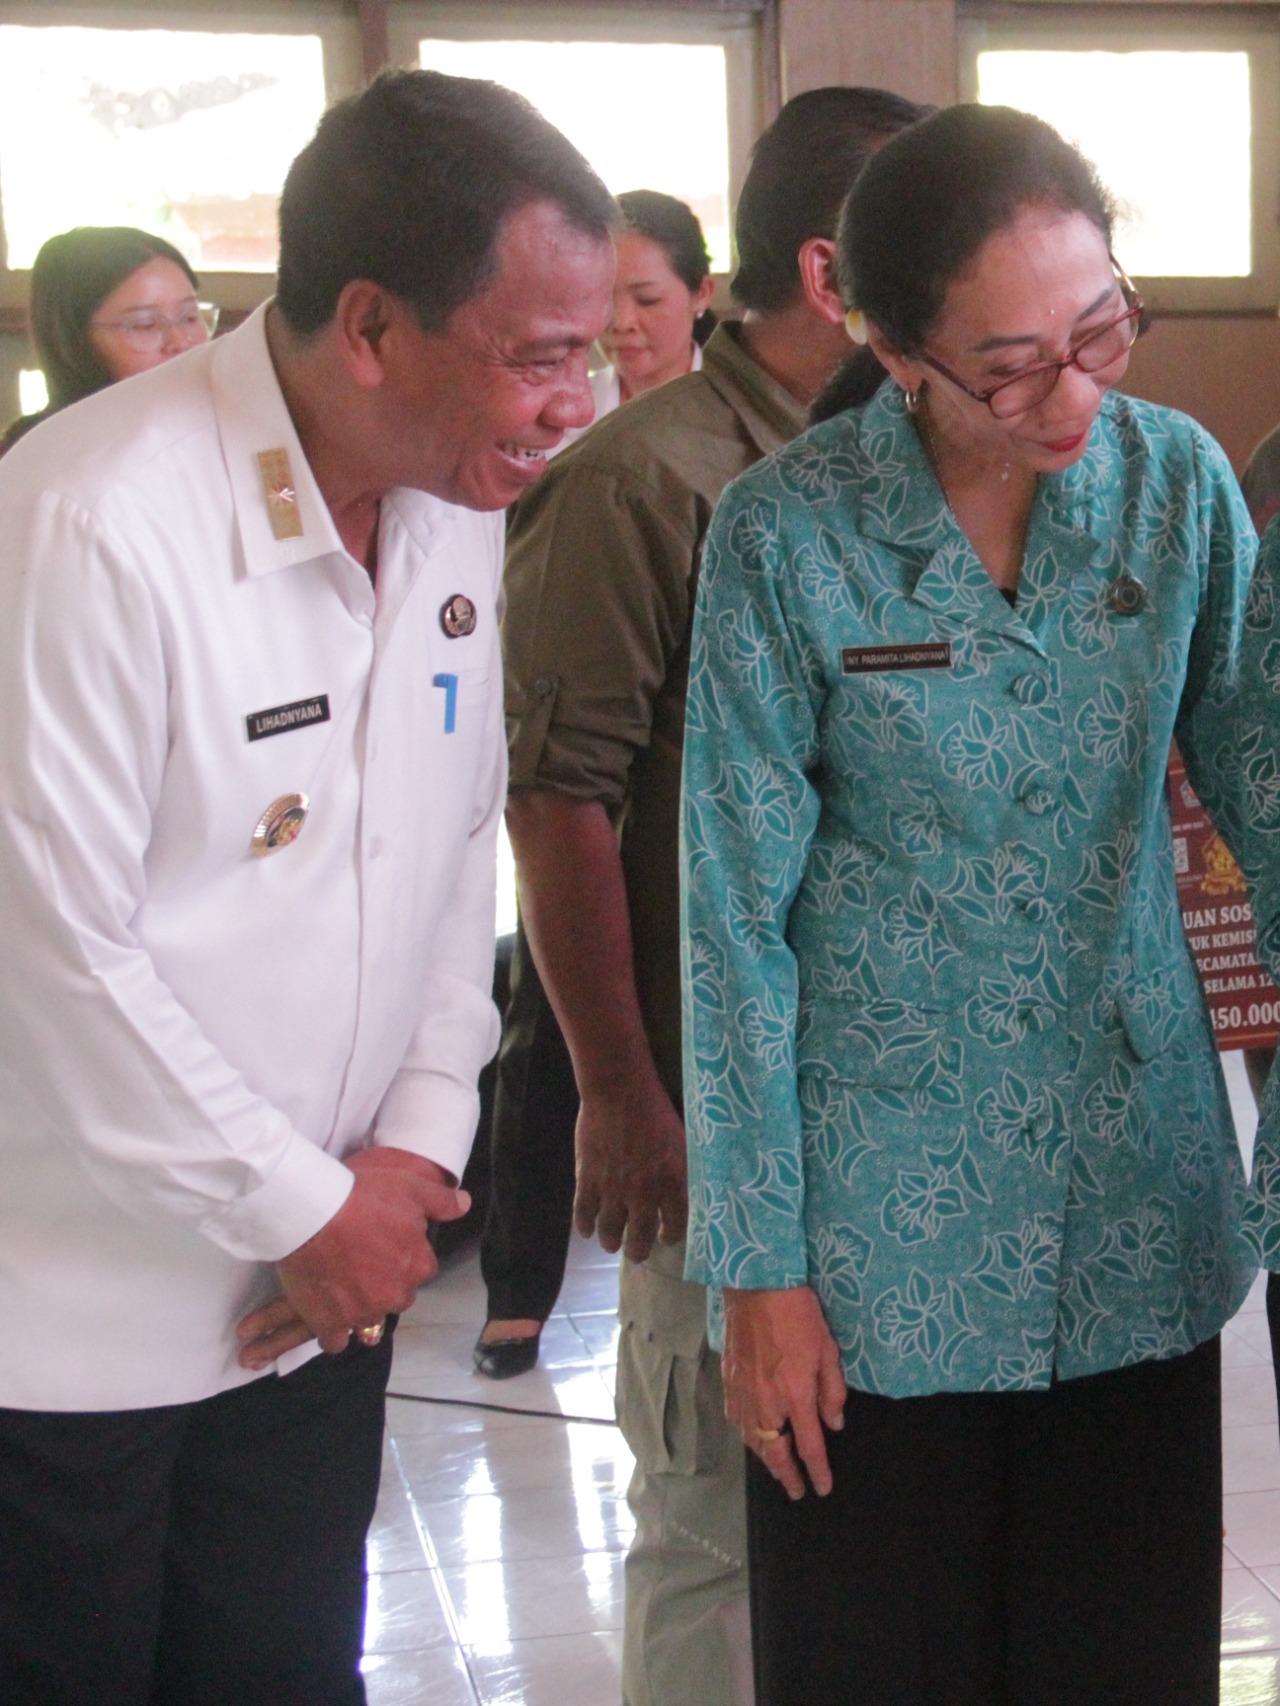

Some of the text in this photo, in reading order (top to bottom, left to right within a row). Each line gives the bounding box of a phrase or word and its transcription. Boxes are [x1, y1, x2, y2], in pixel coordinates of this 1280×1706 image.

[862, 652, 899, 665] PARAMITA
[899, 650, 945, 664] LIHADNYANA
[255, 703, 323, 733] LIHADNYANA
[1204, 975, 1256, 994] SELAMA
